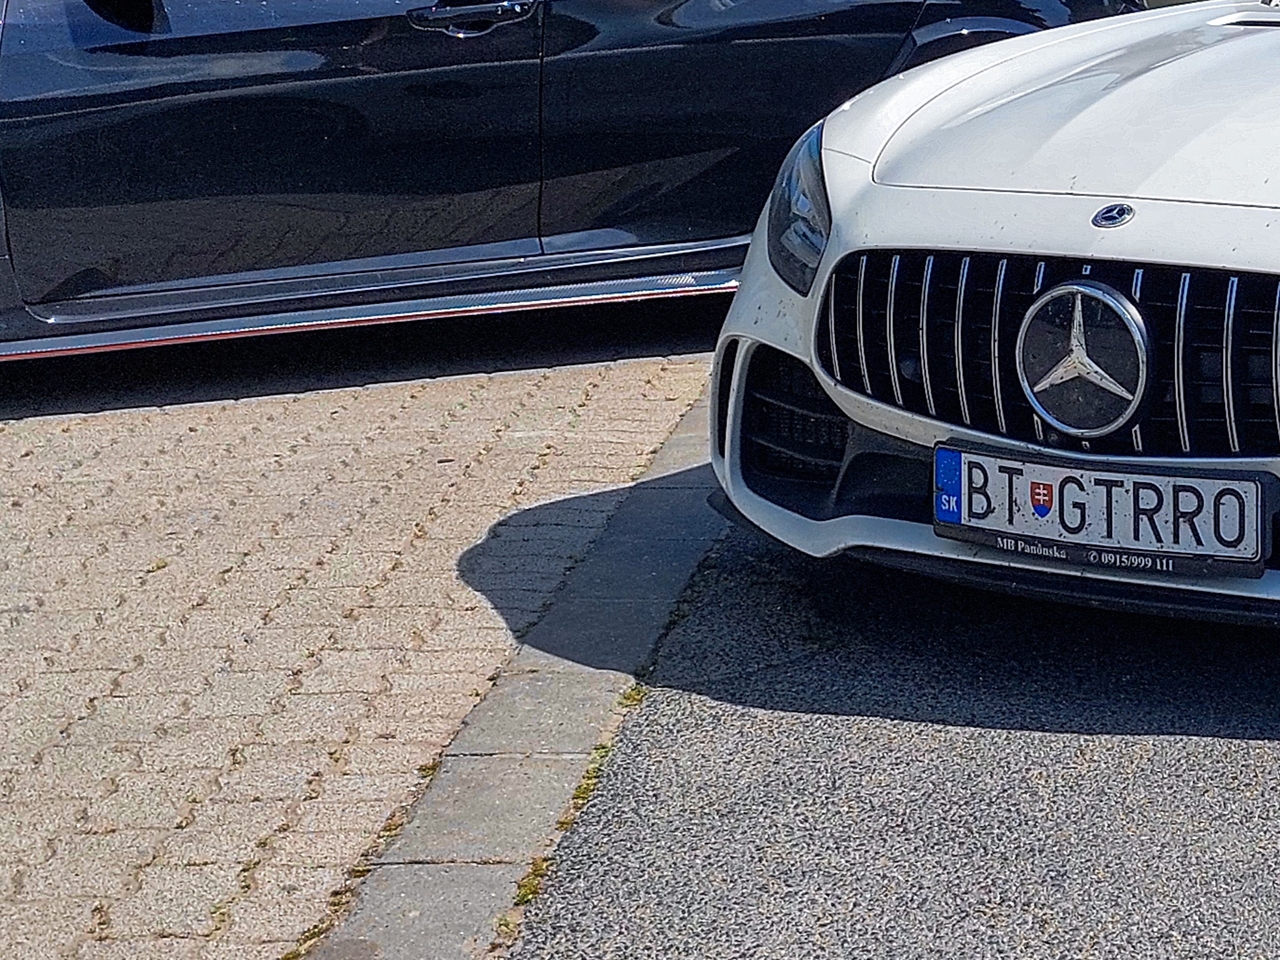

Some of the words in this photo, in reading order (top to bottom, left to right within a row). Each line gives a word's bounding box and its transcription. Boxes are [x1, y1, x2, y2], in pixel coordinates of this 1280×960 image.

[941, 494, 958, 513] SK
[967, 461, 1024, 526] BT
[997, 537, 1015, 551] MB
[1101, 553, 1152, 569] 0915/999
[1156, 558, 1174, 571] 111
